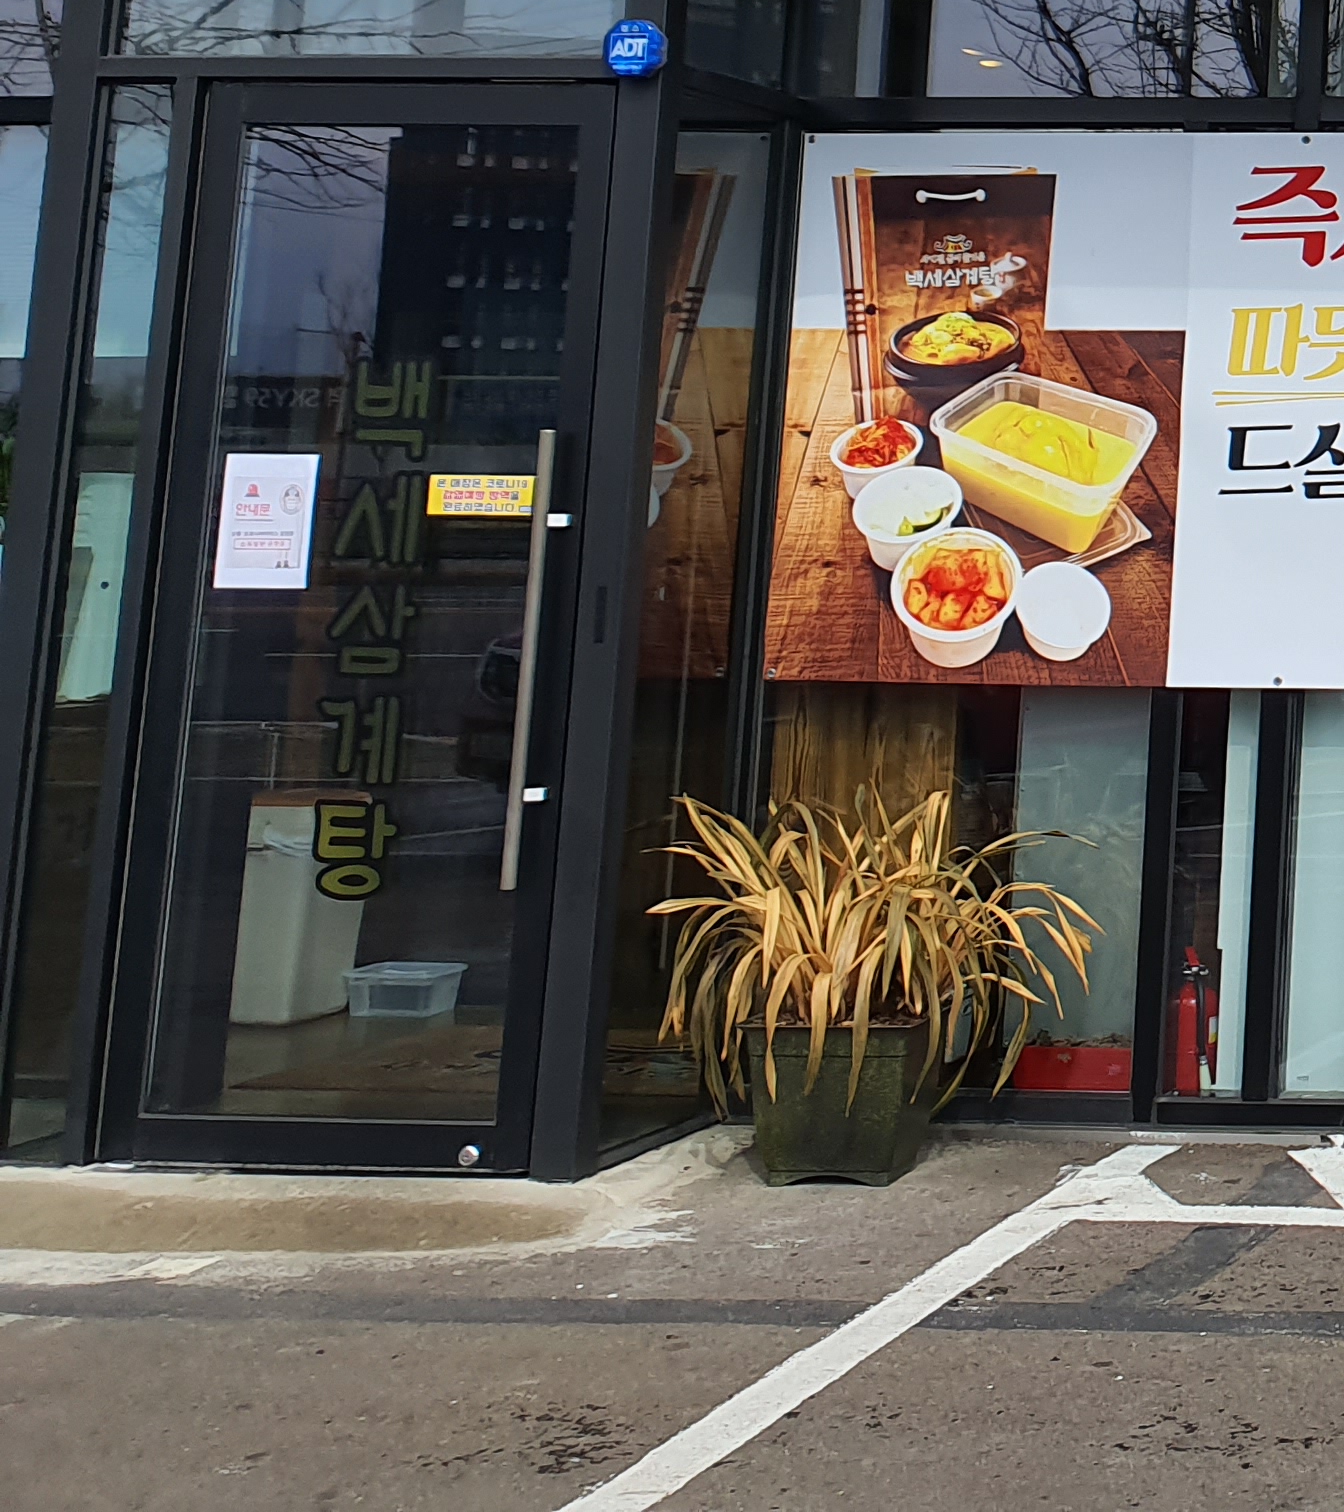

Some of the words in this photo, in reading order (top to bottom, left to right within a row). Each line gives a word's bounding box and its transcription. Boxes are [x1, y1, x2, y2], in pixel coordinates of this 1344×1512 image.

[610, 37, 649, 58] ADT
[235, 503, 271, 517] 안내문
[318, 360, 433, 897] 백세삼계탕
